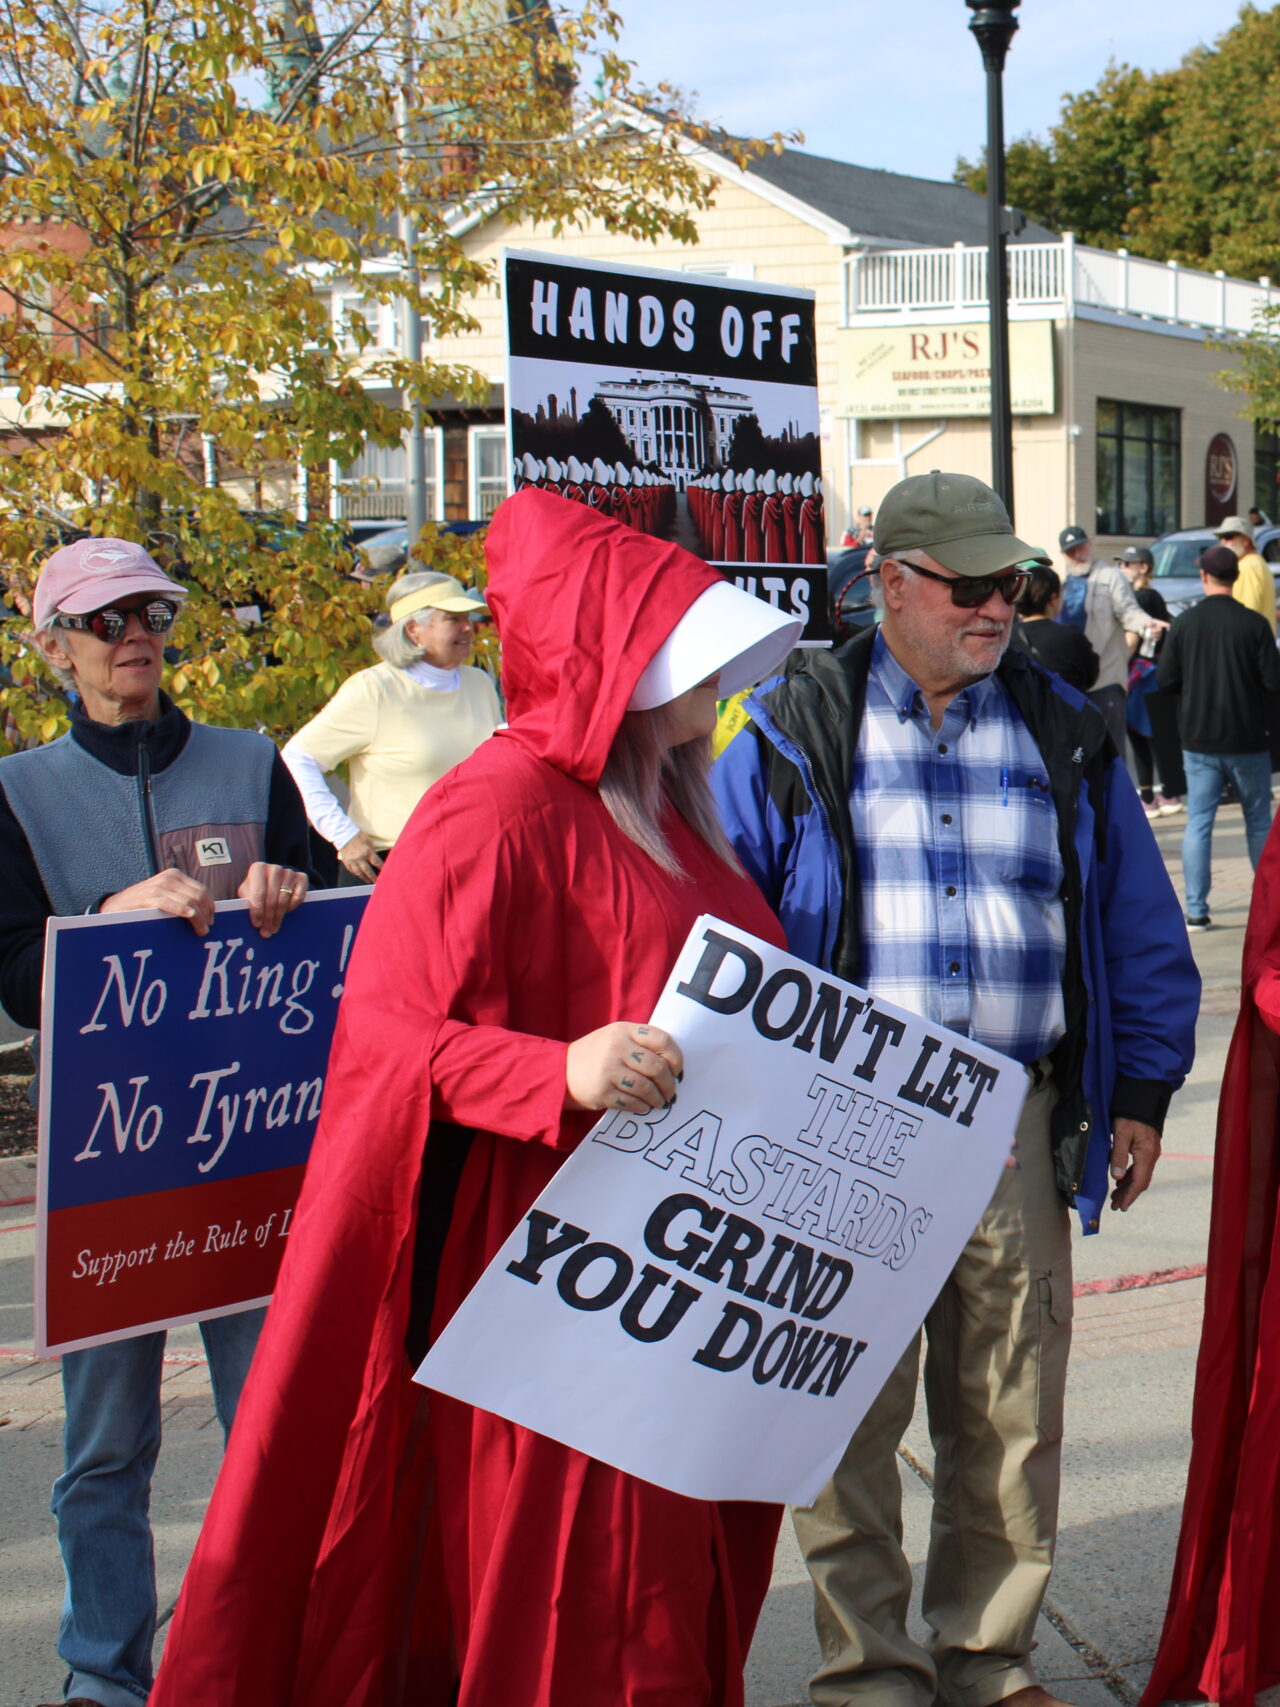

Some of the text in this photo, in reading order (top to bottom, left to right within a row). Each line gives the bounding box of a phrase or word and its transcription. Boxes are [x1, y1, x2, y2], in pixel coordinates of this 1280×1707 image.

[530, 279, 695, 352] HANDS
[719, 305, 801, 364] OFF
[910, 330, 980, 361] RJ'S
[80, 949, 167, 1034] No
[677, 928, 1000, 1127] DON'T LET
[74, 1061, 323, 1173] No Tyran
[797, 1073, 923, 1178] THE
[592, 1100, 931, 1272] BASTARDS
[72, 1242, 157, 1286] Support
[164, 1231, 195, 1260] the
[203, 1222, 249, 1254] Rule
[254, 1214, 275, 1243] of
[505, 1209, 867, 1398] YOU DOWN
[643, 1192, 854, 1322] GRIND
